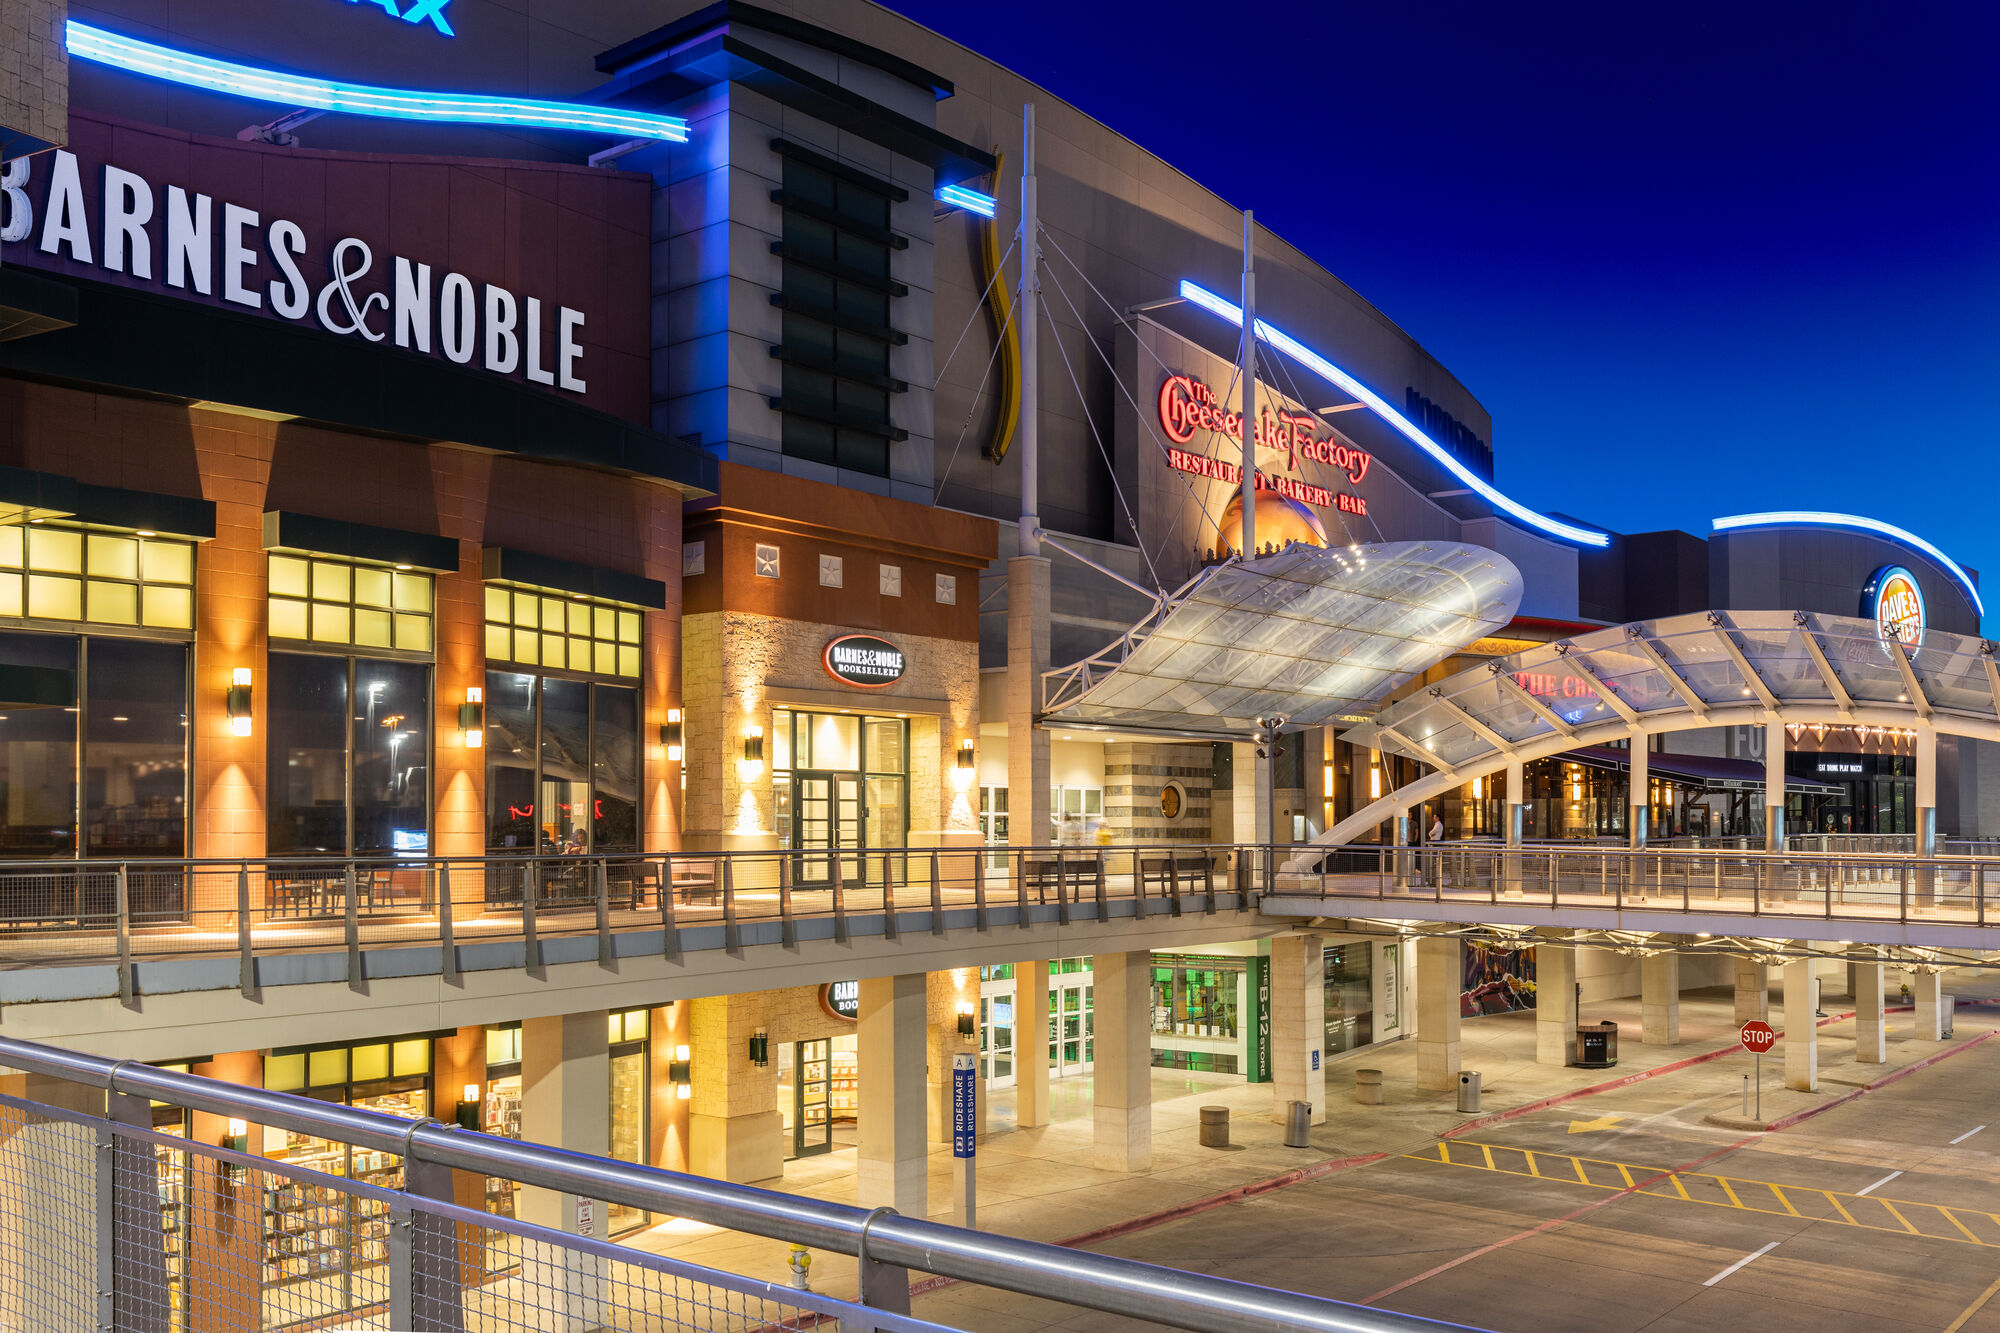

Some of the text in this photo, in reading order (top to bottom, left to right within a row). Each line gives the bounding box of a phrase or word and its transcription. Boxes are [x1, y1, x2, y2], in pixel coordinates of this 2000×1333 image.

[1193, 381, 1217, 405] The
[1280, 411, 1371, 484] Factory
[1277, 478, 1333, 507] BAKERY
[1340, 494, 1367, 516] BAR
[1882, 591, 1910, 622] DAVE
[838, 663, 899, 677] BOOKSELLERS
[1514, 672, 1557, 697] THE
[1839, 764, 1849, 772] PLAY
[1259, 986, 1269, 1036] B-12
[1743, 1029, 1773, 1044] STOP
[956, 1058, 963, 1067] A
[968, 1058, 974, 1067] A
[955, 1075, 964, 1132] RIDESHARE
[913, 1280, 931, 1294] LANE
[934, 1276, 945, 1287] NO
